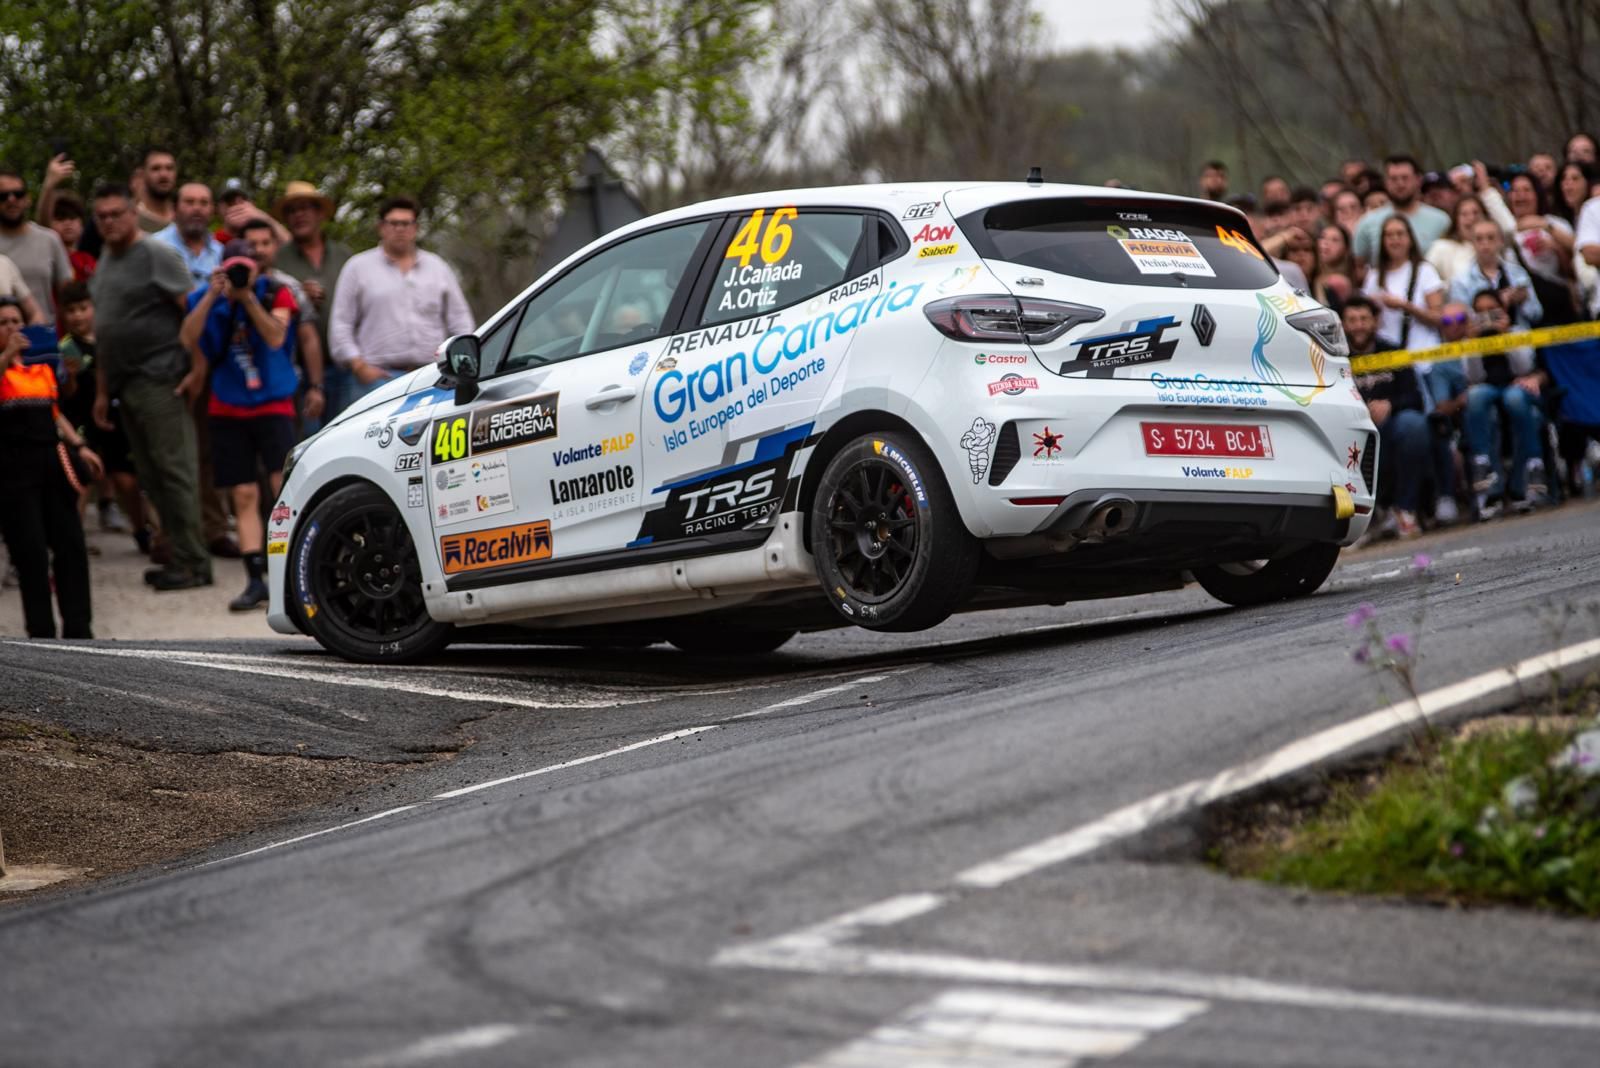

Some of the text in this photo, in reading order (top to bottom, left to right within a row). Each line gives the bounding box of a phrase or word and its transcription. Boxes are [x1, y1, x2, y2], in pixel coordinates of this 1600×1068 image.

[725, 204, 799, 267] 46
[913, 224, 955, 243] AON
[1129, 227, 1193, 242] RADSA
[920, 245, 955, 257] Sabelt
[1139, 243, 1184, 255] Recalvi
[723, 260, 803, 288] J.Cañada
[718, 287, 778, 312] A.Ortiz
[828, 274, 880, 304] RADSA
[667, 313, 781, 356] RENAULT
[1088, 336, 1151, 360] TRS
[653, 281, 925, 424] Gran Canaria
[988, 354, 1028, 364] Castrol
[1093, 353, 1153, 368] RACING TEAM
[1151, 372, 1263, 393] Gran Canaria
[663, 357, 826, 452] Isla Europea del Deporte
[1158, 392, 1268, 406] Isla Europea del Deporte
[490, 403, 543, 428] SIERRA
[435, 418, 466, 461] 46
[490, 416, 555, 443] MORENA
[1174, 429, 1216, 450] 5734
[1225, 430, 1257, 452] BCJ
[552, 432, 635, 467] VolanteFALP
[549, 464, 635, 506] Lanzarote
[889, 450, 925, 501] MICHELIN
[1181, 466, 1253, 479] VolanteFALP
[553, 493, 636, 520] LA ISLA DIFERENTE
[679, 467, 777, 520] TRS
[685, 502, 778, 535] RACING TEAM
[464, 529, 532, 566] Recalvi
